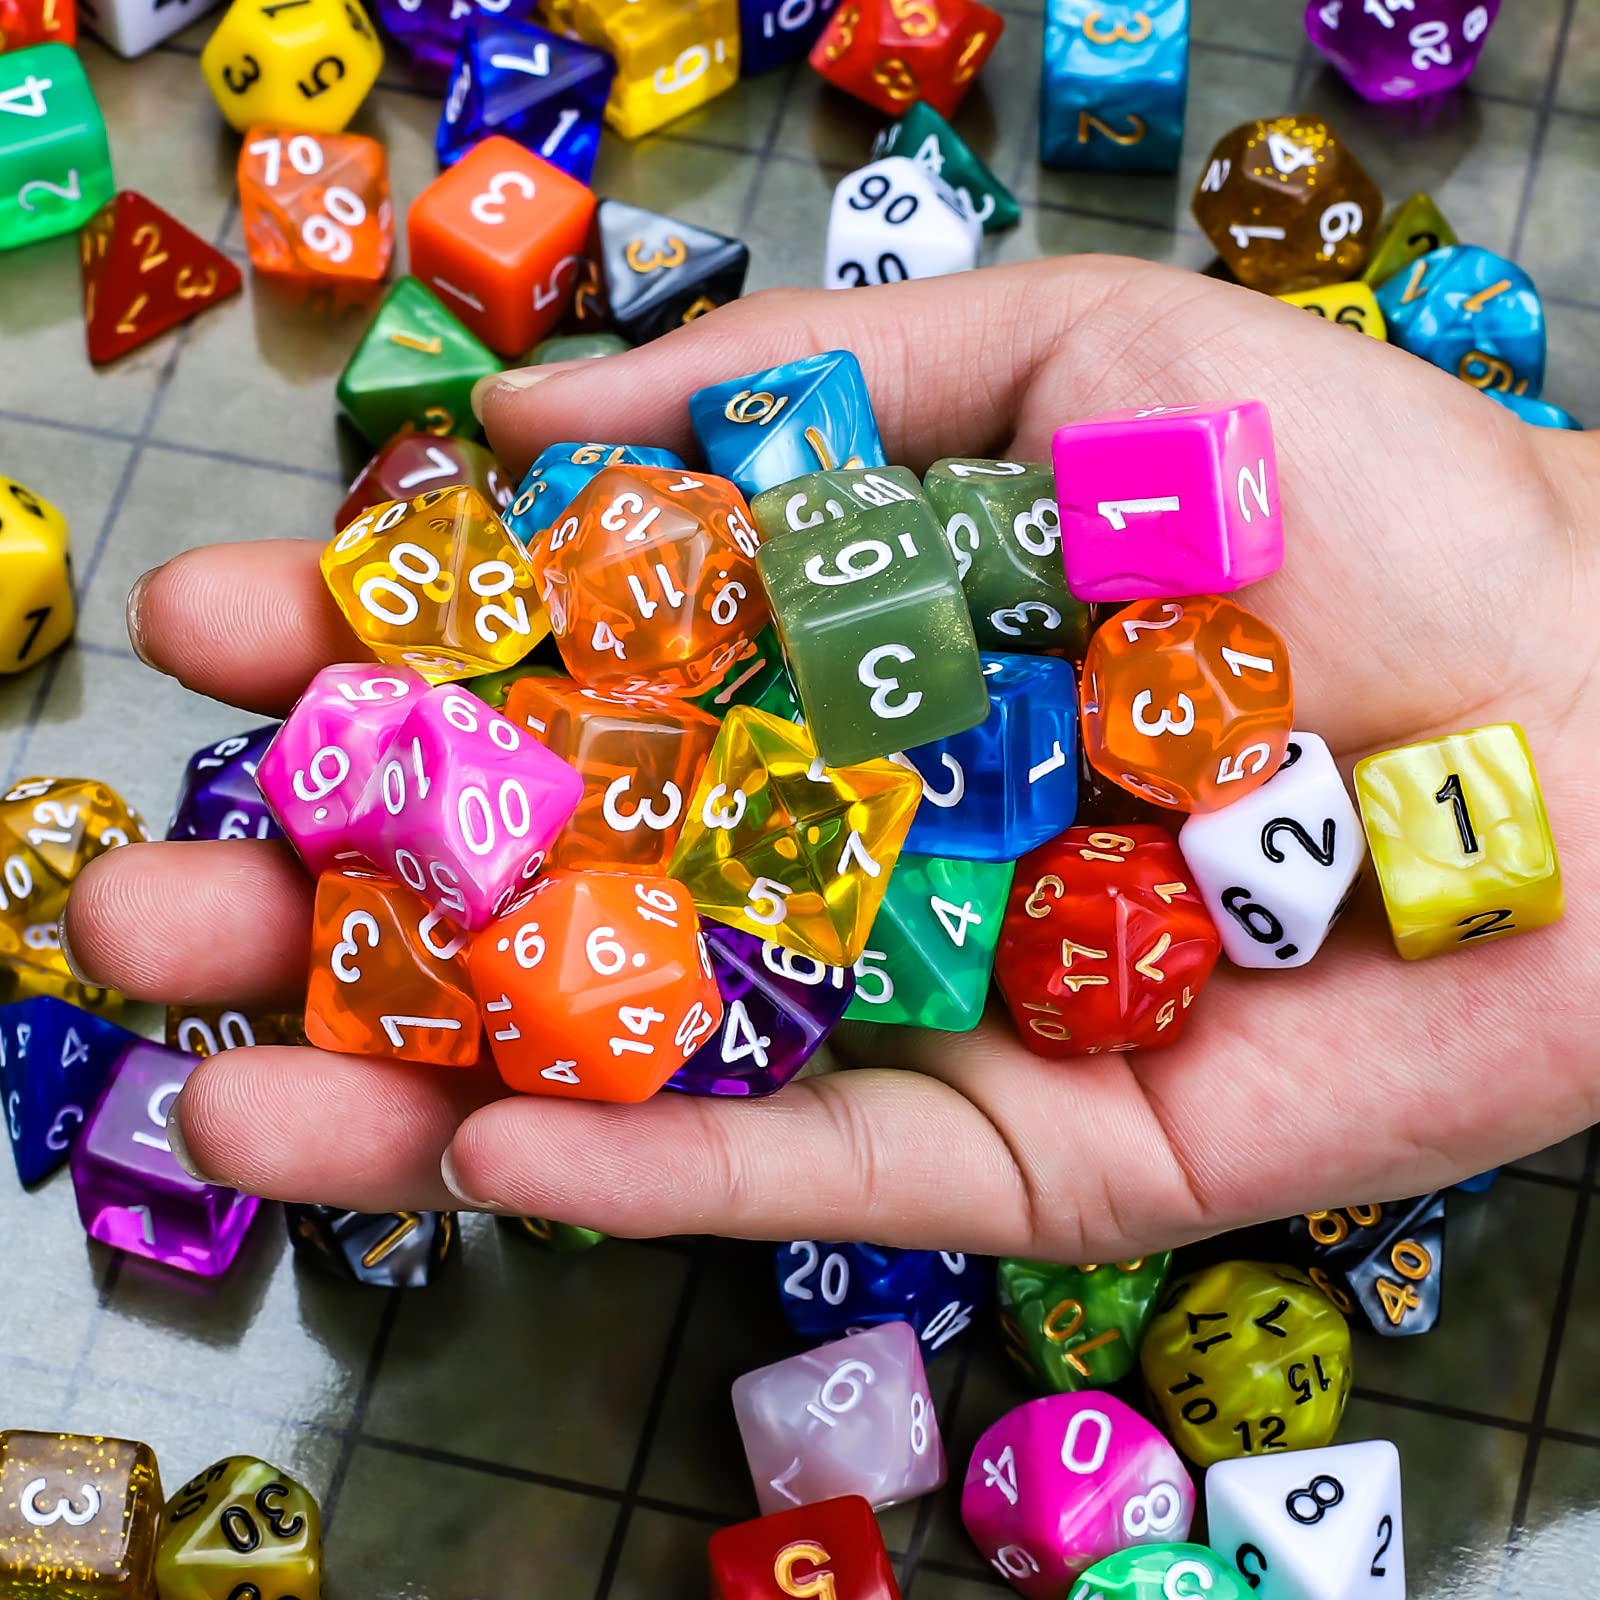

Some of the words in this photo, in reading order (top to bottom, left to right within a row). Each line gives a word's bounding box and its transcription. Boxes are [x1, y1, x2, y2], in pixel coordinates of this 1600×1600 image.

[1082, 10, 1152, 45] 3
[1407, 20, 1453, 71] 20
[222, 54, 260, 95] 3
[296, 55, 346, 100] 5
[491, 43, 550, 77] 7
[0, 74, 52, 118] 4
[1077, 110, 1147, 147] 2
[1266, 131, 1319, 175] 4
[248, 134, 324, 187] 70
[18, 168, 81, 213] 2
[470, 170, 536, 225] 3
[848, 174, 919, 225] 90
[131, 223, 170, 274] 2
[301, 185, 367, 264] 90
[1228, 222, 1287, 249] 1
[625, 236, 687, 274] 3
[175, 266, 217, 300] 3
[432, 276, 485, 313] 1
[532, 254, 577, 312] 5
[391, 330, 442, 355] 1
[398, 446, 459, 490] 7
[947, 461, 1027, 478] 2
[1237, 458, 1271, 524] 2
[334, 502, 408, 553] 60
[600, 491, 662, 542] 13
[1012, 497, 1062, 557] 8
[1096, 495, 1181, 531] 1
[358, 541, 441, 627] 00
[467, 560, 533, 645] 20
[626, 562, 686, 620] 11
[591, 619, 628, 661] 4
[990, 600, 1062, 636] 3
[1121, 602, 1185, 642] 2
[857, 643, 923, 719] 3
[1220, 646, 1275, 678] 1
[336, 676, 410, 702] 5
[1131, 689, 1195, 737] 3
[441, 695, 521, 752] 60
[383, 735, 432, 816] 10
[1027, 740, 1067, 785] 1
[1215, 742, 1272, 785] 5
[27, 800, 80, 847] 12
[457, 778, 531, 856] 00
[602, 774, 683, 832] 3
[701, 782, 748, 831] 3
[1435, 773, 1480, 855] 1
[1260, 816, 1337, 867] 2
[395, 848, 466, 914] 50
[633, 882, 679, 928] 16
[743, 876, 794, 927] 5
[1024, 874, 1065, 919] 3
[330, 908, 381, 984] 3
[930, 895, 982, 948] 4
[1455, 908, 1517, 943] 2
[1061, 937, 1111, 993] 17
[485, 993, 522, 1042] 11
[608, 1005, 666, 1057] 14
[673, 1001, 714, 1059] 20
[720, 999, 772, 1068] 4
[59, 1025, 90, 1069] 4
[539, 1059, 581, 1085] 4
[45, 1104, 84, 1152] 3
[783, 1240, 850, 1306] 20
[1375, 1239, 1433, 1325] 40
[1186, 1311, 1233, 1354] 17
[1168, 1372, 1218, 1426] 10
[1287, 1354, 1332, 1405] 15
[909, 1391, 929, 1457] 8
[1060, 1408, 1113, 1475] 0
[1232, 1415, 1288, 1453] 12
[982, 1444, 1019, 1506] 4
[1285, 1474, 1345, 1526] 8
[19, 1476, 102, 1527] 3
[220, 1483, 304, 1553] 30
[1122, 1481, 1182, 1538] 8
[1370, 1514, 1394, 1578] 2
